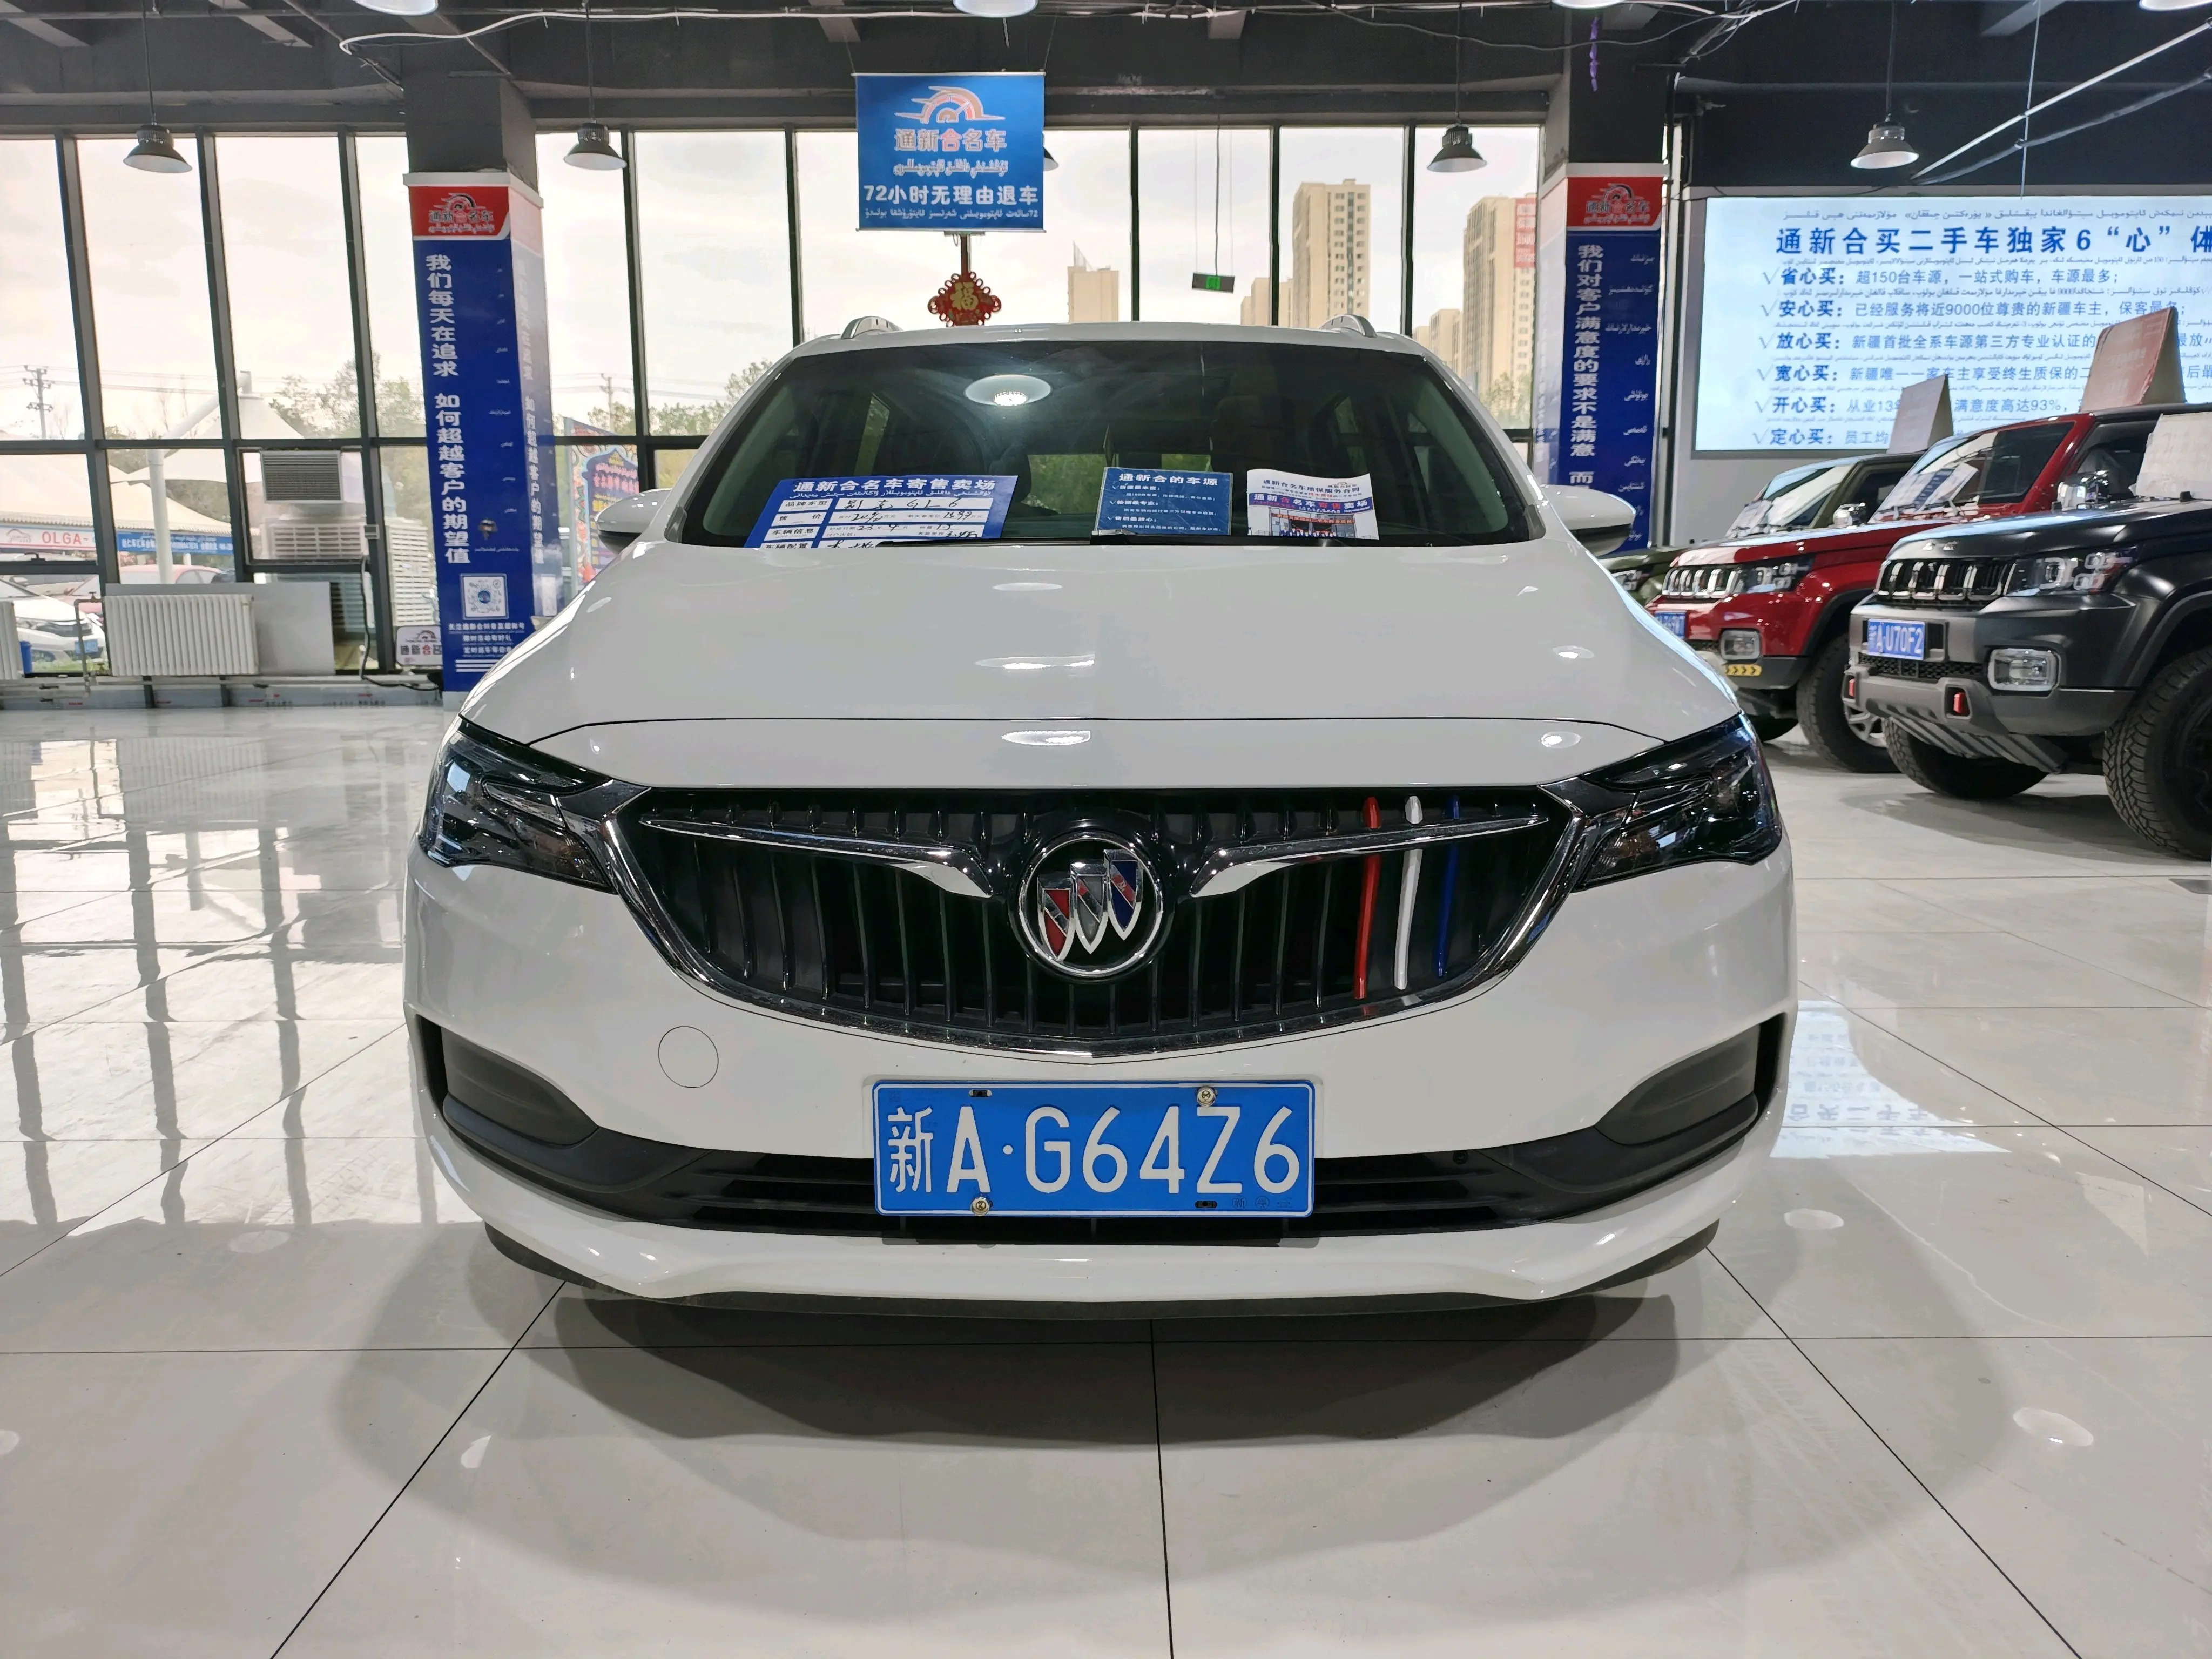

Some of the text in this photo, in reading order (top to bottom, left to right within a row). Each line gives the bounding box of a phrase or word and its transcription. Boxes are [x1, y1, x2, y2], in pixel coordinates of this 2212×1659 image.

[894, 128, 1007, 152] 通新合名车
[864, 185, 1038, 205] 72小时无理由退车
[1781, 267, 1844, 286] 省心买：
[1778, 300, 1842, 318] 安心买：
[1776, 332, 1840, 350] 放心买：
[1570, 244, 1604, 457] 我们对客户满意度的要求不是满意
[1775, 364, 1838, 382] 宽心买：
[425, 254, 471, 564] 我们每天在追求 如何超越客户的期望值
[1772, 396, 1836, 414] 开心买：
[1769, 428, 1832, 446] 定心买：
[793, 478, 996, 493] 通新合名车寄售卖场
[1118, 473, 1218, 486] 通新合的车源
[887, 1105, 1300, 1194] 新A·G64Z6
